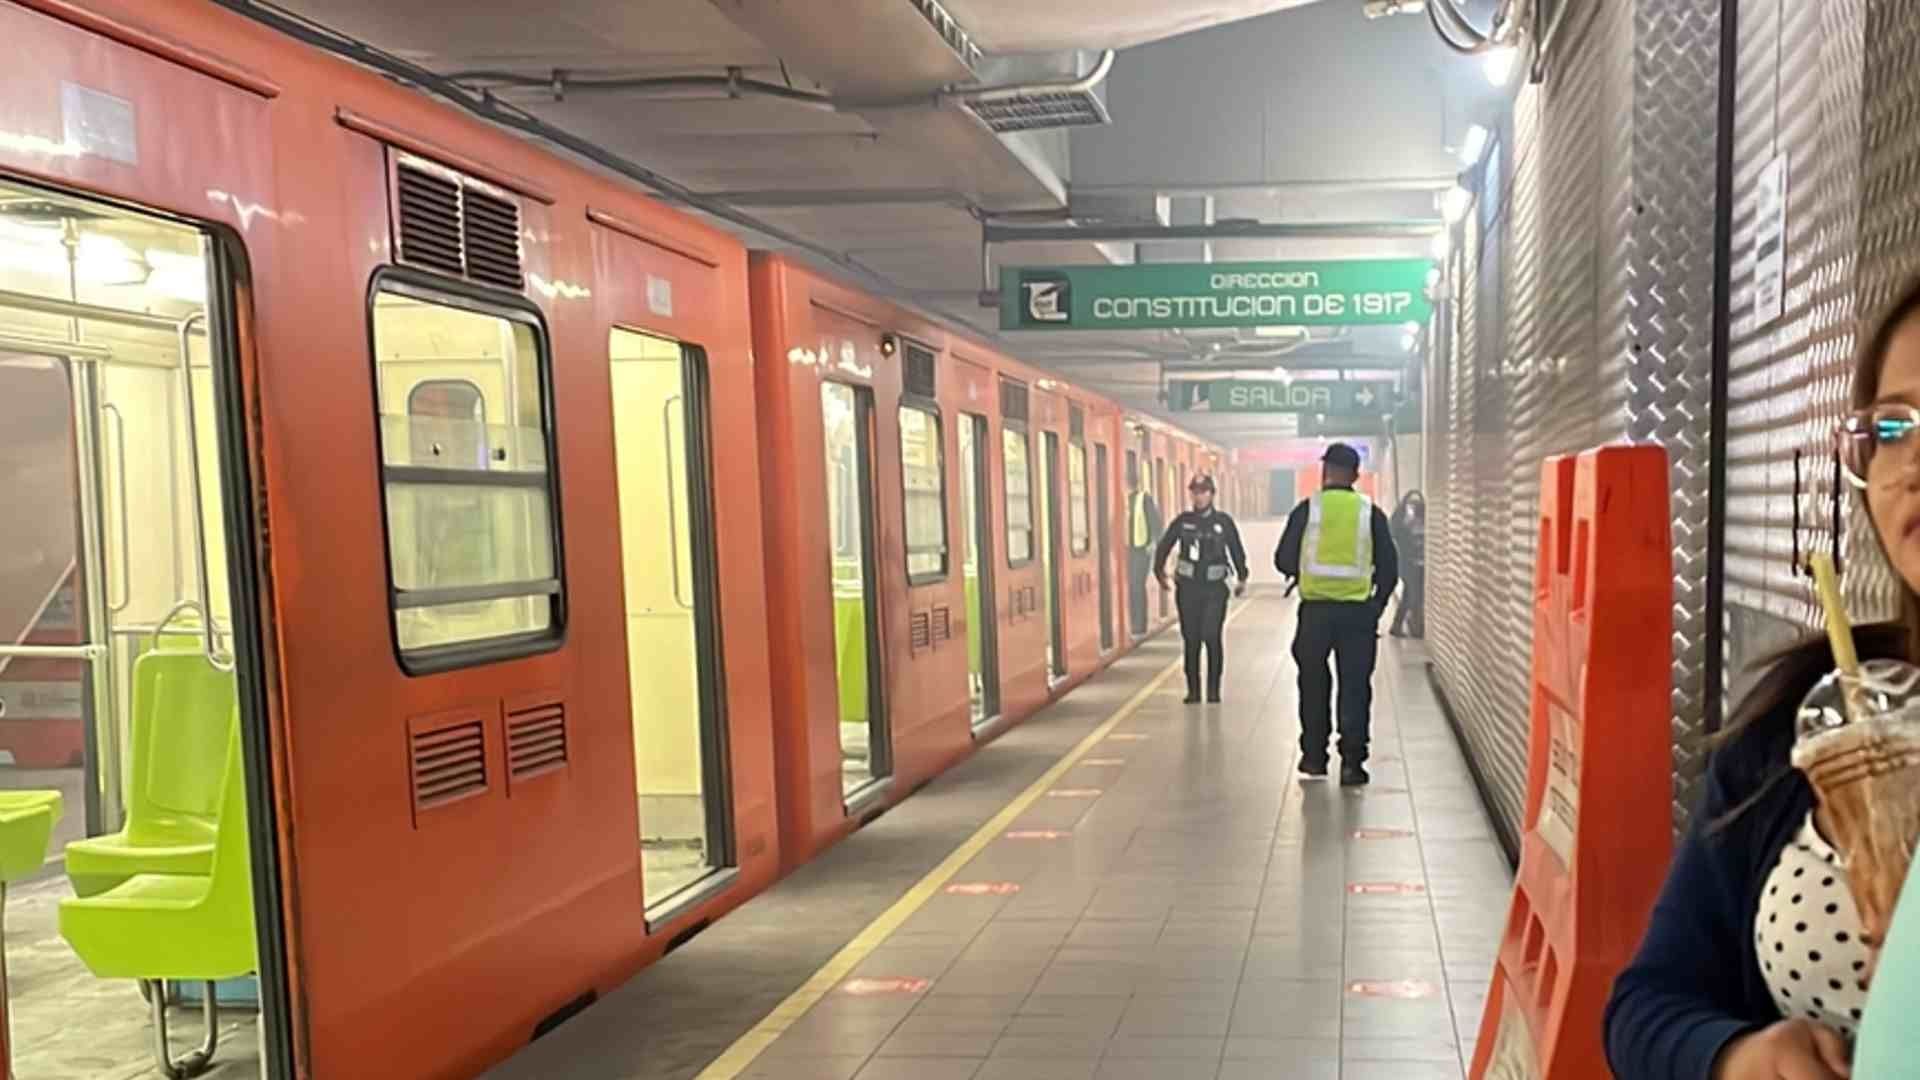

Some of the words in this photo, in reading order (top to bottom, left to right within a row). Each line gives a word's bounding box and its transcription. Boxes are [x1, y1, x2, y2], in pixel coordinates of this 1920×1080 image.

[1210, 271, 1319, 289] DIRECCION
[1093, 294, 1297, 319] CONSTITUCION
[1303, 292, 1346, 317] DE
[1352, 290, 1413, 316] 1917
[1229, 386, 1331, 408] SALIDA
